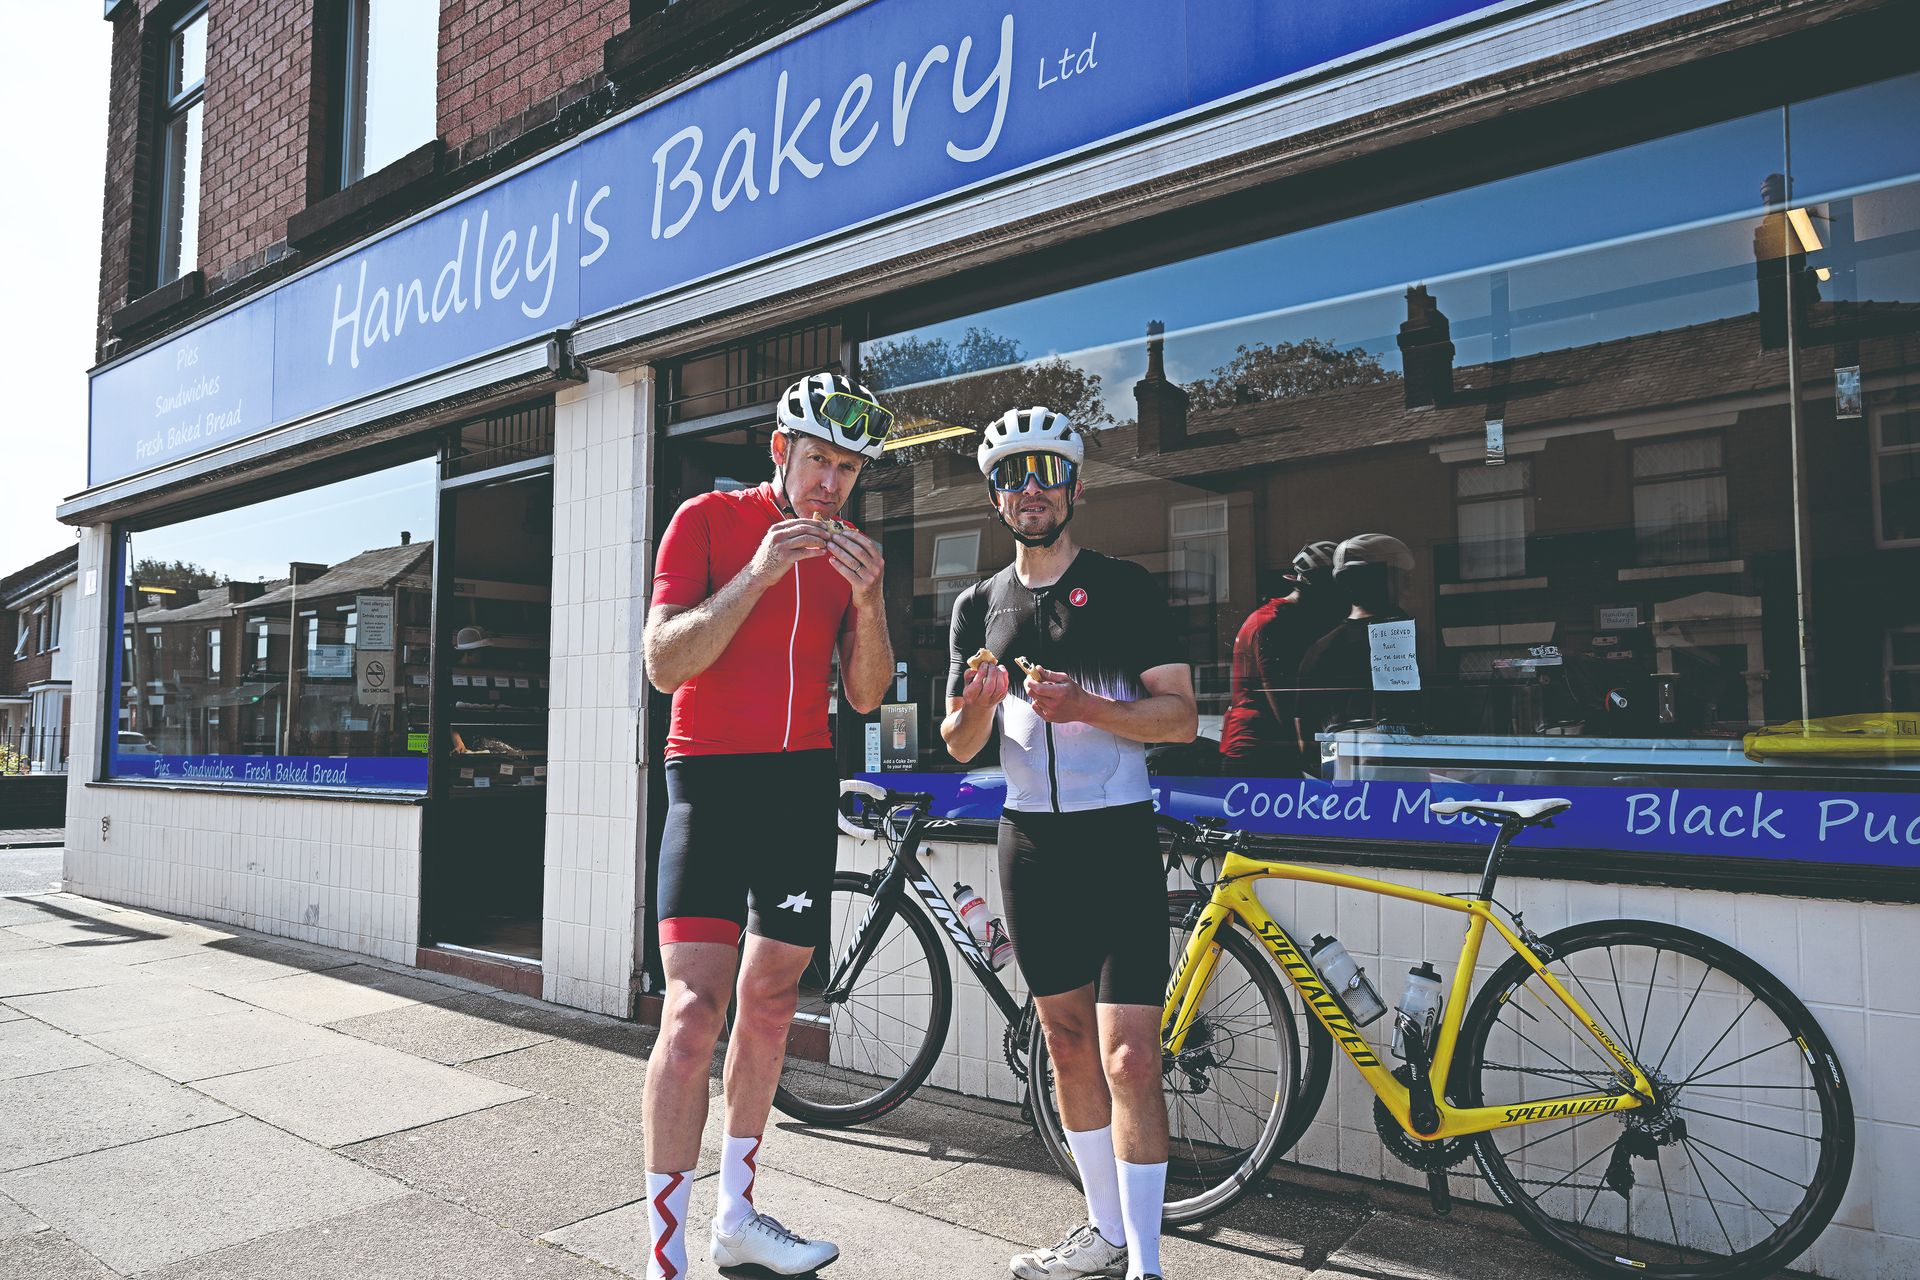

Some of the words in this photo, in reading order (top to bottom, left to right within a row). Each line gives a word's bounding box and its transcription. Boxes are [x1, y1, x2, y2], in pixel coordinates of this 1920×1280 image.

[327, 179, 610, 369] Handley's
[651, 13, 1014, 240] Bakery
[1038, 31, 1098, 90] Ltd
[176, 343, 199, 371] Pies
[155, 375, 220, 418] Sandwiches
[136, 431, 164, 461] Fresh
[167, 413, 201, 450] Baked
[205, 398, 242, 436] Bread
[1390, 628, 1411, 636] SERVED
[154, 758, 171, 777] Pies
[182, 760, 234, 779] Sandwiches
[244, 761, 271, 781] Fresh
[275, 762, 308, 782] Baked
[312, 762, 348, 784] Bread
[1222, 781, 1371, 822] Cooked
[1626, 788, 1786, 839] Black
[843, 899, 880, 966] TIME
[913, 874, 992, 973] TIME
[1251, 920, 1381, 1067] SPECIALIZED
[1590, 1020, 1635, 1070] TARMAC
[1500, 1098, 1619, 1123] SPECIALIZED
[1474, 1140, 1514, 1207] CONTINENTAL
